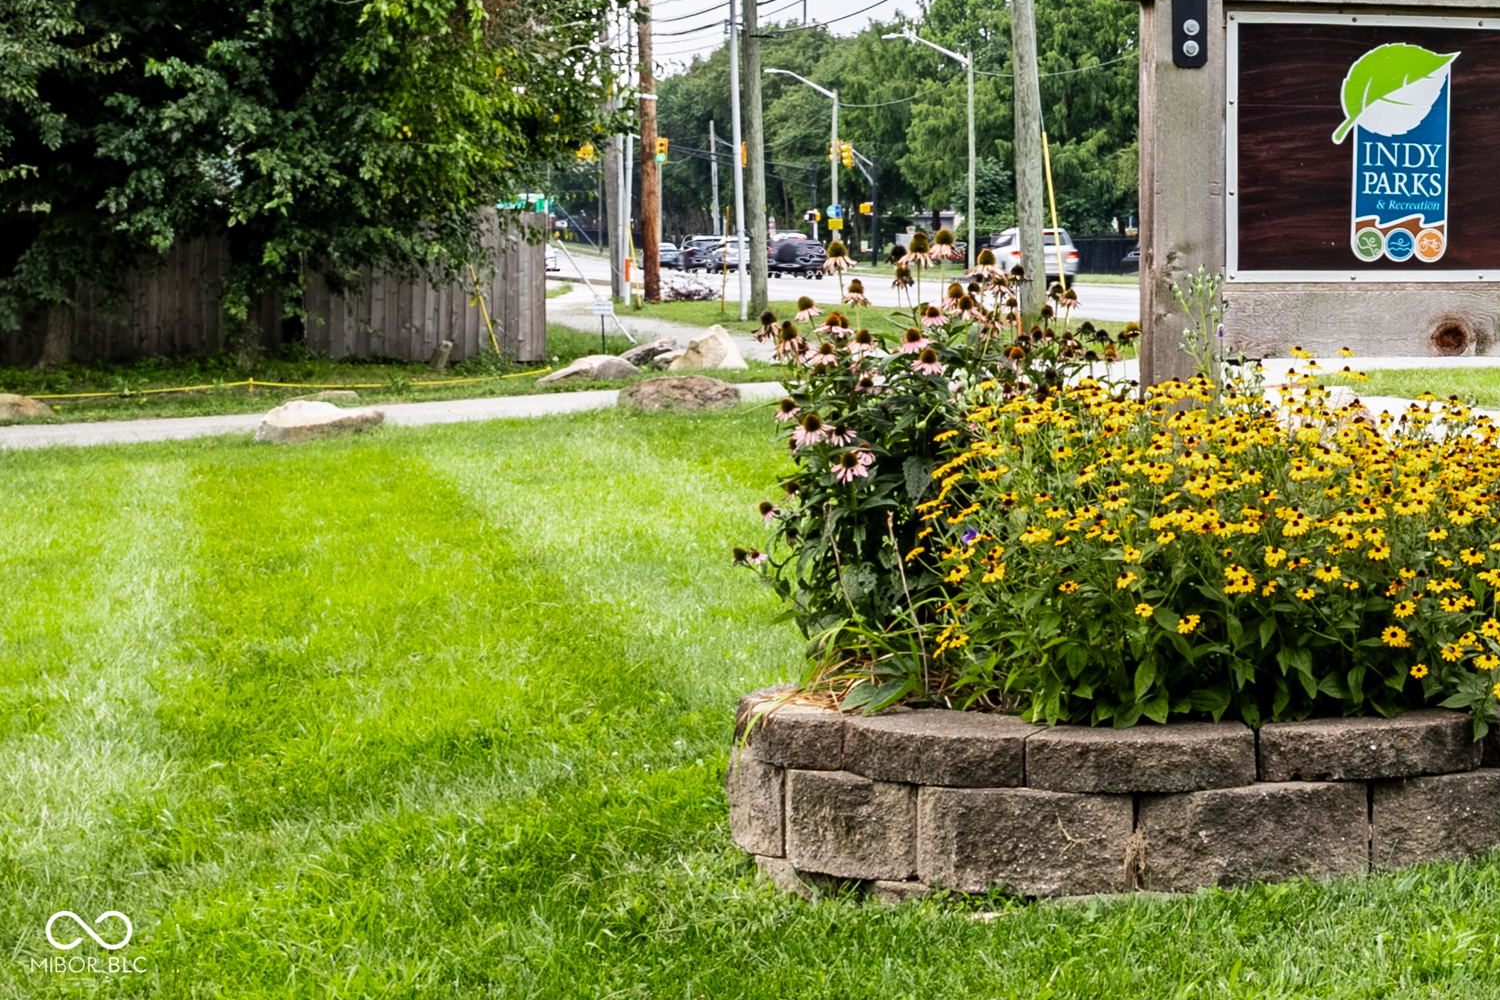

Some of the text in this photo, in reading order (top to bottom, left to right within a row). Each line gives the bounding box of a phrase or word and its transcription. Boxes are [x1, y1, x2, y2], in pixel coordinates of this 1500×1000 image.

[1362, 141, 1443, 169] INDY
[1361, 171, 1442, 198] PARKS
[1376, 199, 1440, 211] & Recreation
